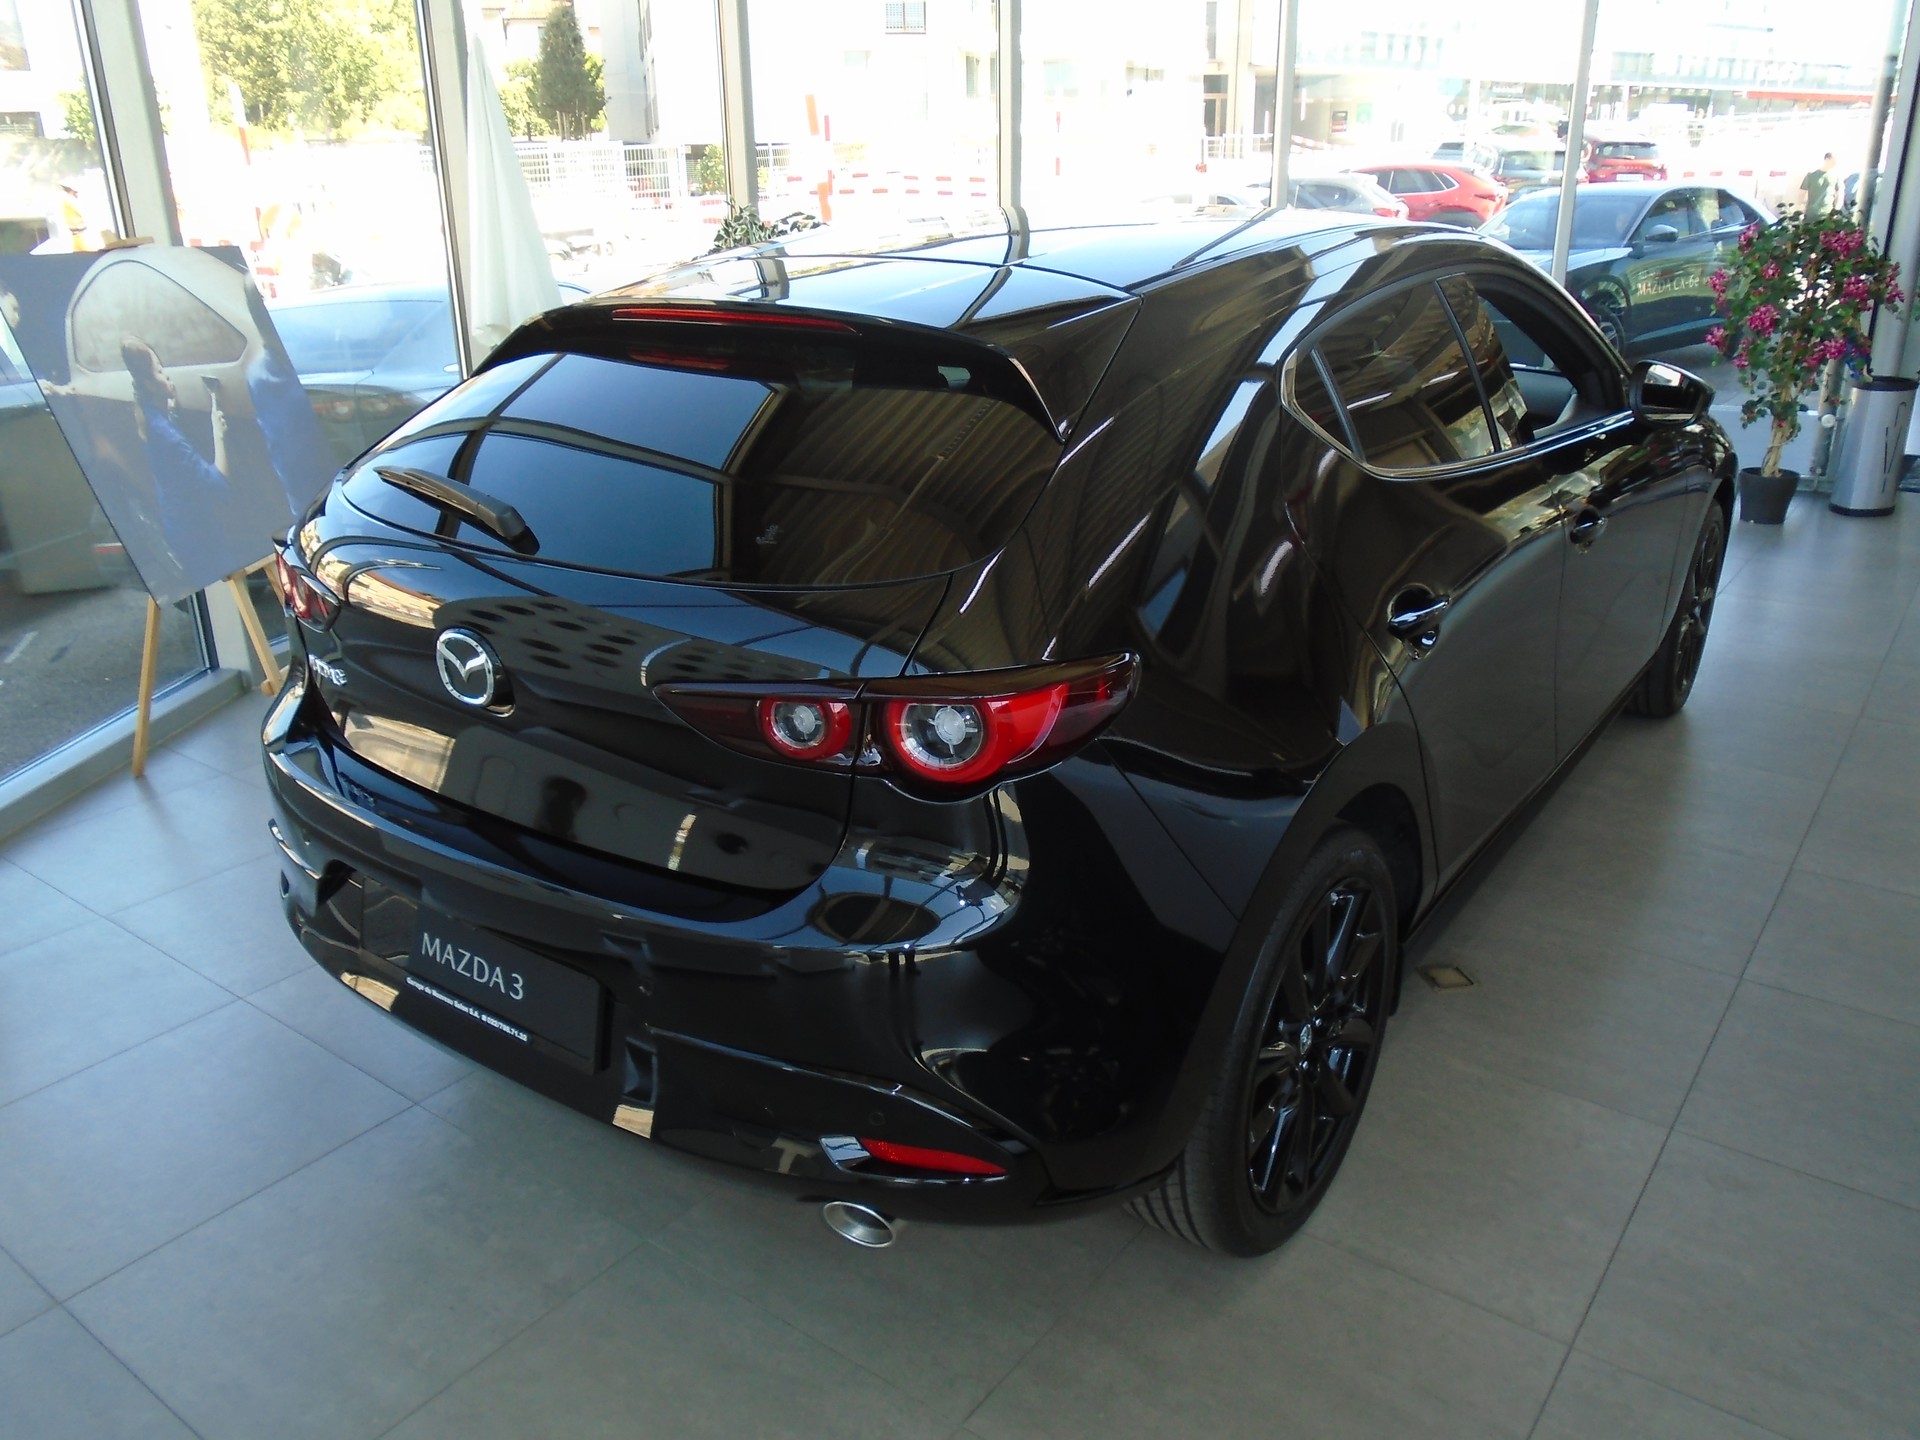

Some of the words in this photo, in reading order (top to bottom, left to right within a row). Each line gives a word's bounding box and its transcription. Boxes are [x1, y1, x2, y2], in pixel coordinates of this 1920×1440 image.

[1637, 279, 1673, 297] MAZDA
[421, 931, 506, 994] MAZDA
[509, 973, 524, 1000] 3
